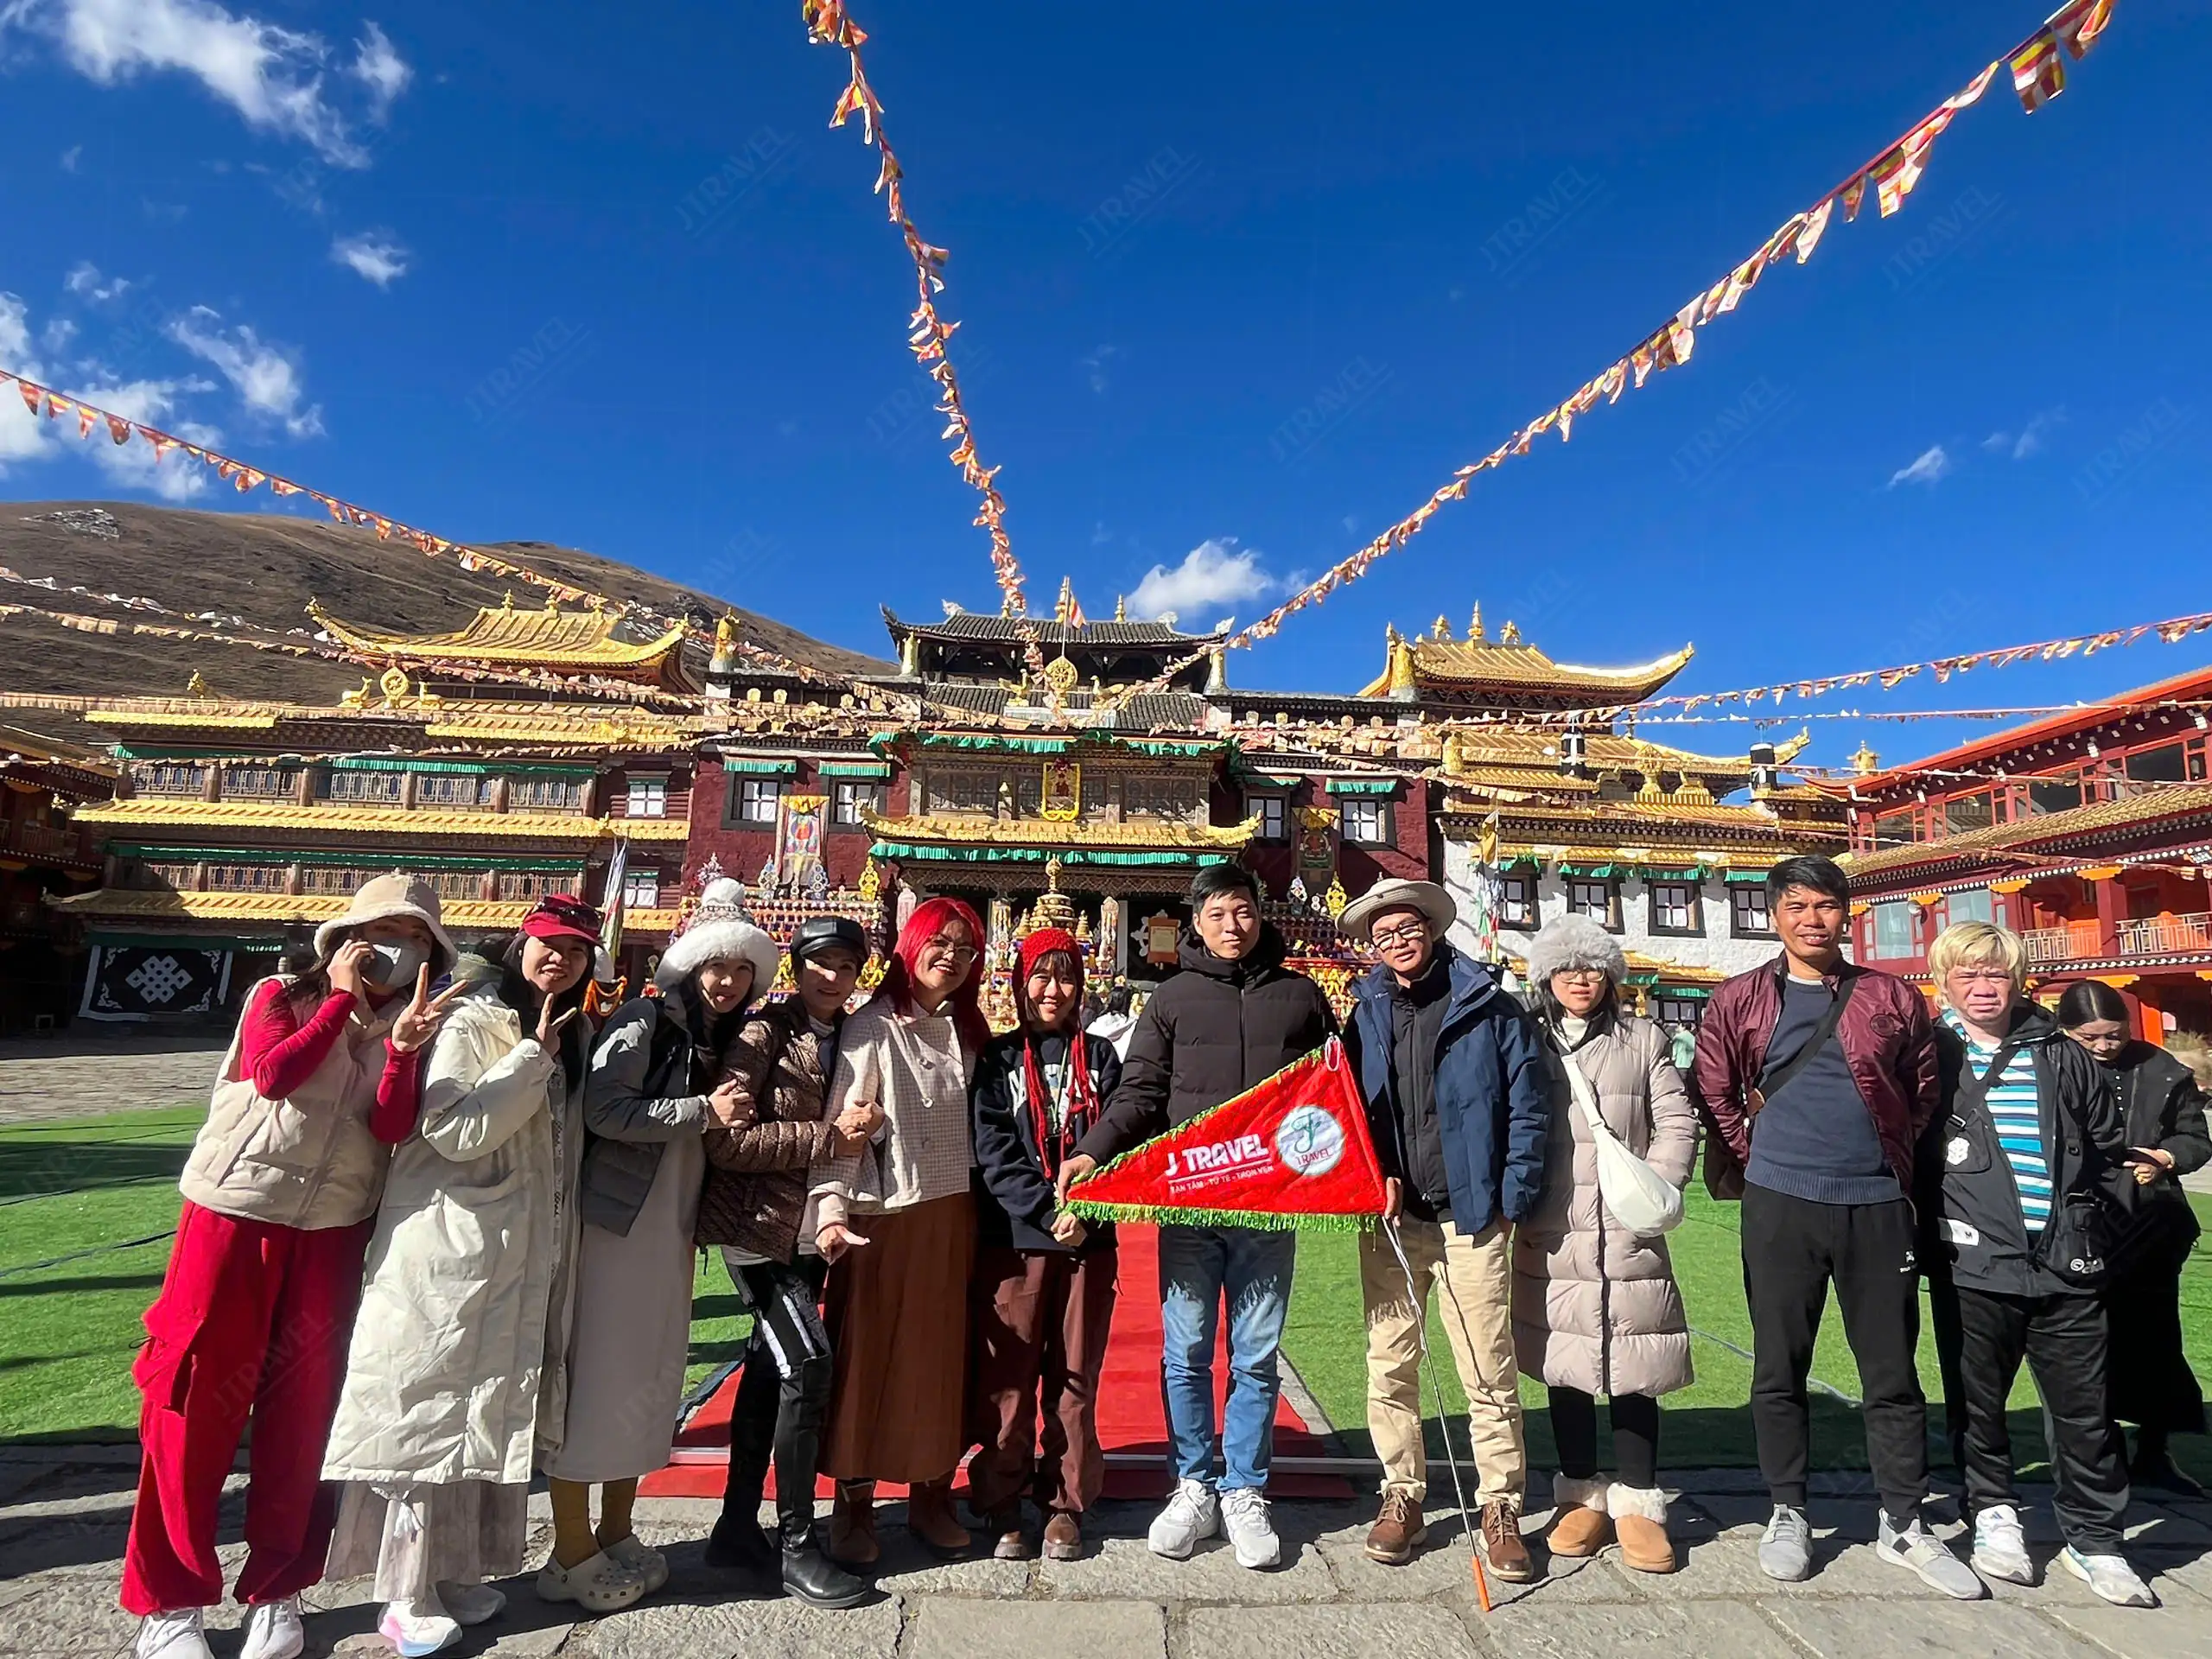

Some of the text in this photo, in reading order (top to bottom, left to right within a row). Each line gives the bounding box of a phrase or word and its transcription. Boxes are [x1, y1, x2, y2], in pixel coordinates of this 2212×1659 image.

[1164, 1134, 1269, 1176] J TRAVEL
[1295, 1147, 1334, 1166] TRAVEL
